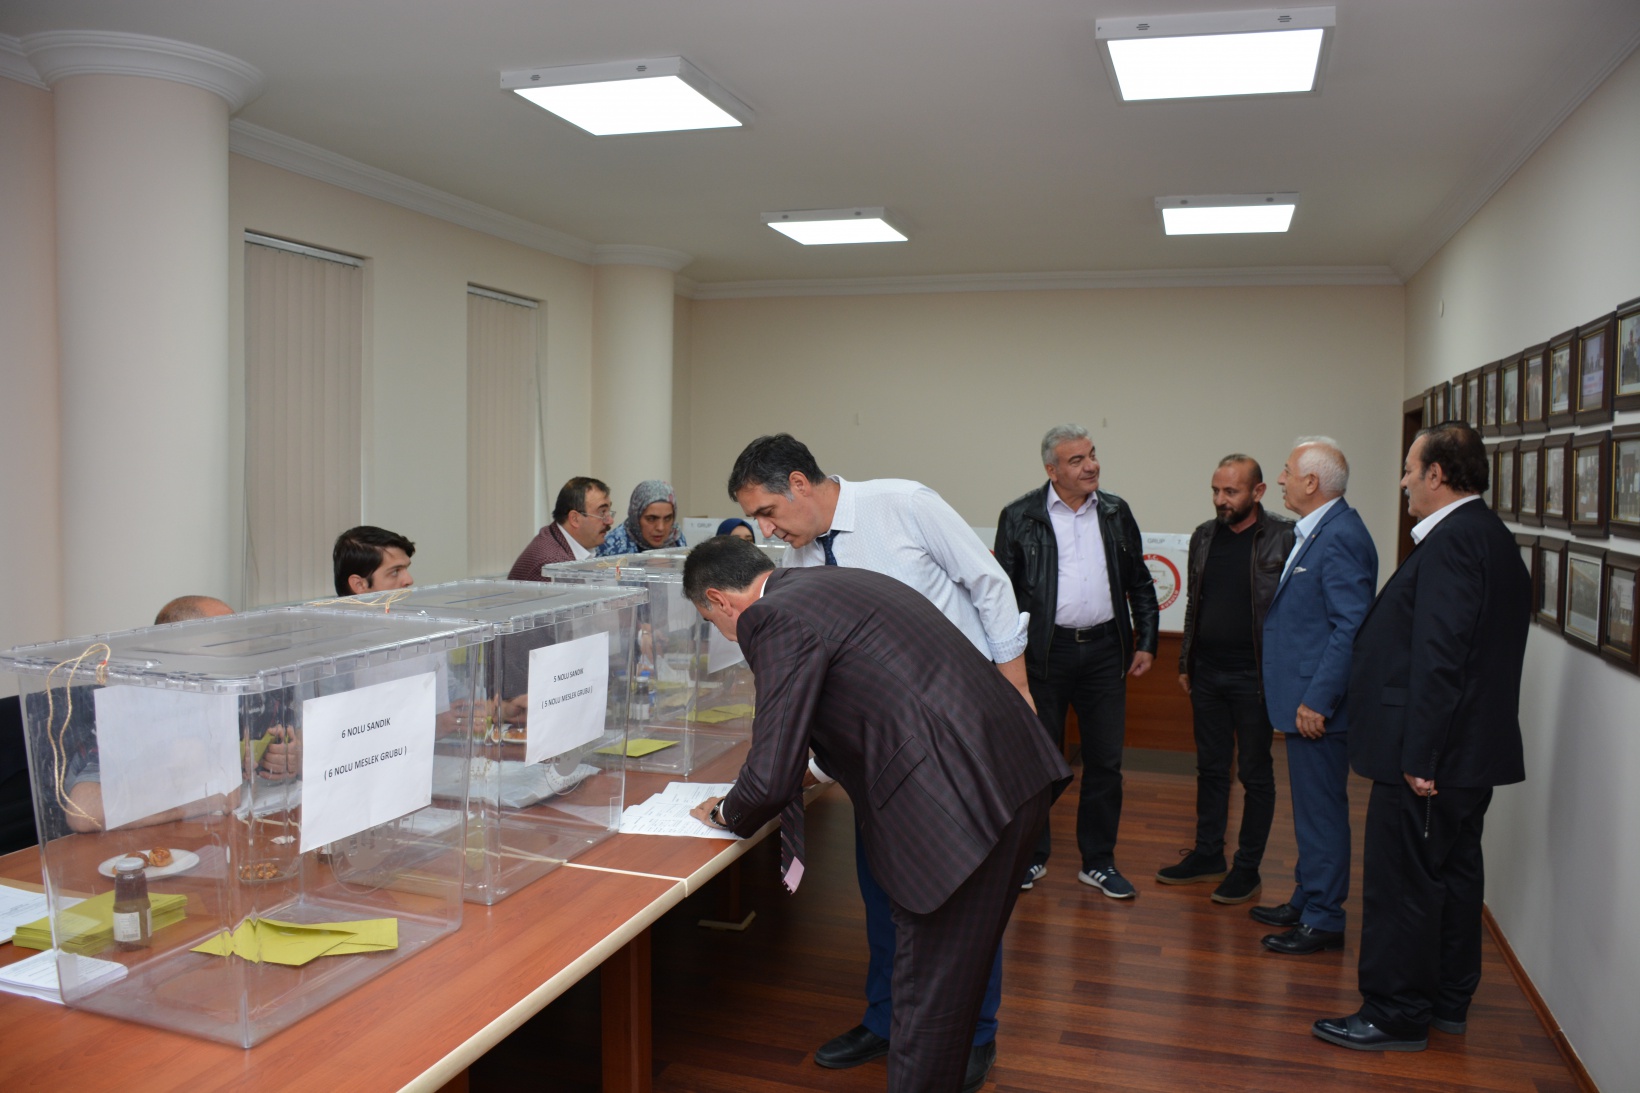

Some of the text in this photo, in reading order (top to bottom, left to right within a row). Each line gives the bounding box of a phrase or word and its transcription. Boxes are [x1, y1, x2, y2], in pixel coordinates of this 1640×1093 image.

[553, 667, 584, 683] 5 NOLU SANDIK
[548, 697, 561, 706] NOLU
[561, 692, 577, 702] MESLEK
[577, 686, 591, 697] GRUBU
[341, 717, 391, 738] 6 NOLU SANDIK
[328, 768, 333, 778] 6
[334, 762, 353, 776] NOLU
[354, 754, 379, 770] MESLEK
[380, 747, 403, 761] GRUBU
